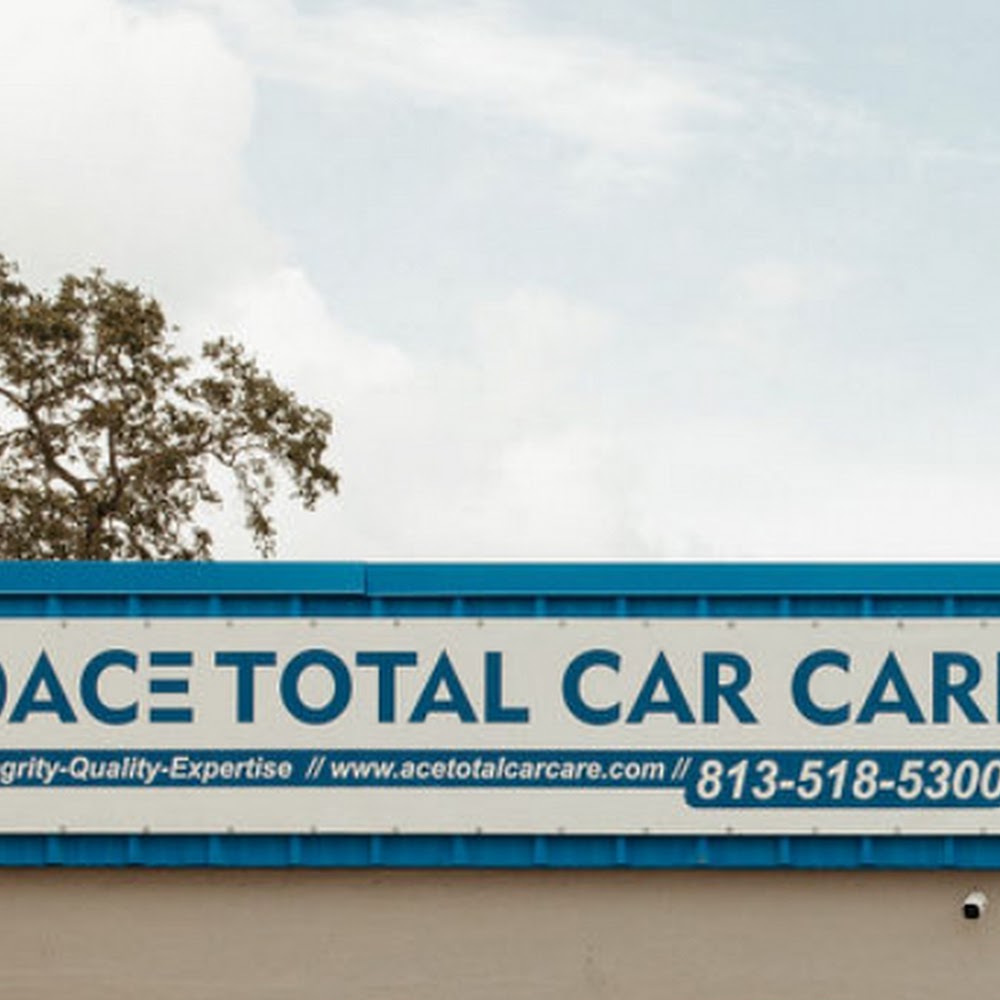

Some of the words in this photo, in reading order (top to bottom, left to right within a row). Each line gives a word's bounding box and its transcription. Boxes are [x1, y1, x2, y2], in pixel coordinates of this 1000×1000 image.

[8, 649, 194, 726] ACE
[214, 649, 530, 726] TOTAL
[561, 649, 759, 726] CAR
[331, 757, 665, 780] www.acetotalcarcare.com
